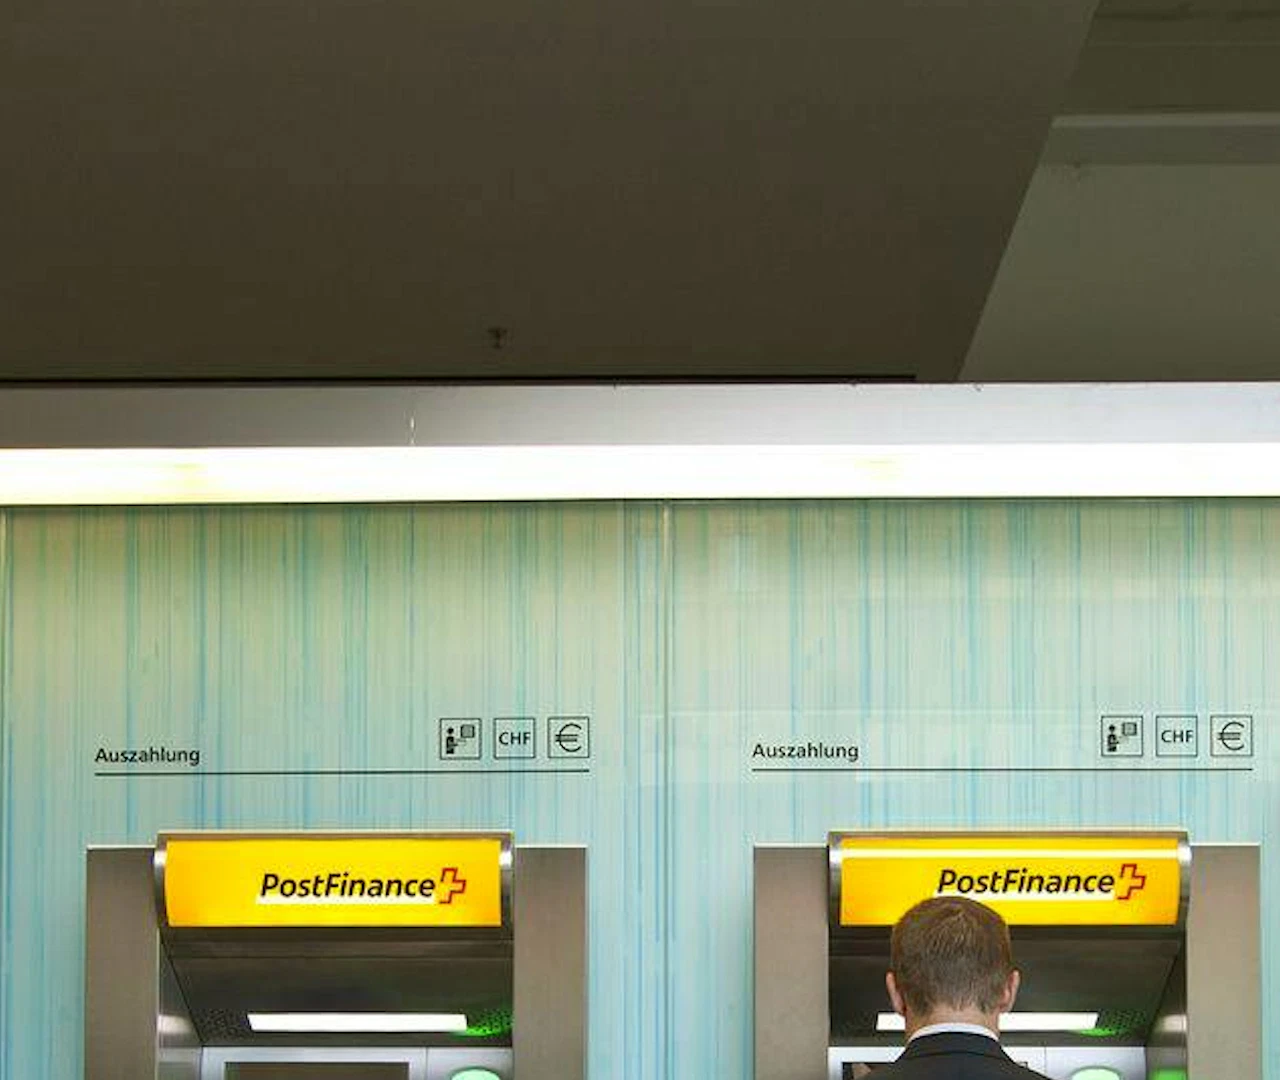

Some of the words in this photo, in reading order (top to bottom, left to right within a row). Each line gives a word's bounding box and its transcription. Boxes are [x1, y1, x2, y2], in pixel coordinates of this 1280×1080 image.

[498, 731, 531, 747] CHF
[1161, 729, 1194, 744] CHF
[95, 746, 201, 766] Auszahlung
[752, 742, 859, 763] Auszahlung
[261, 872, 436, 897] PostFinance
[937, 868, 1114, 893] PostFinance
